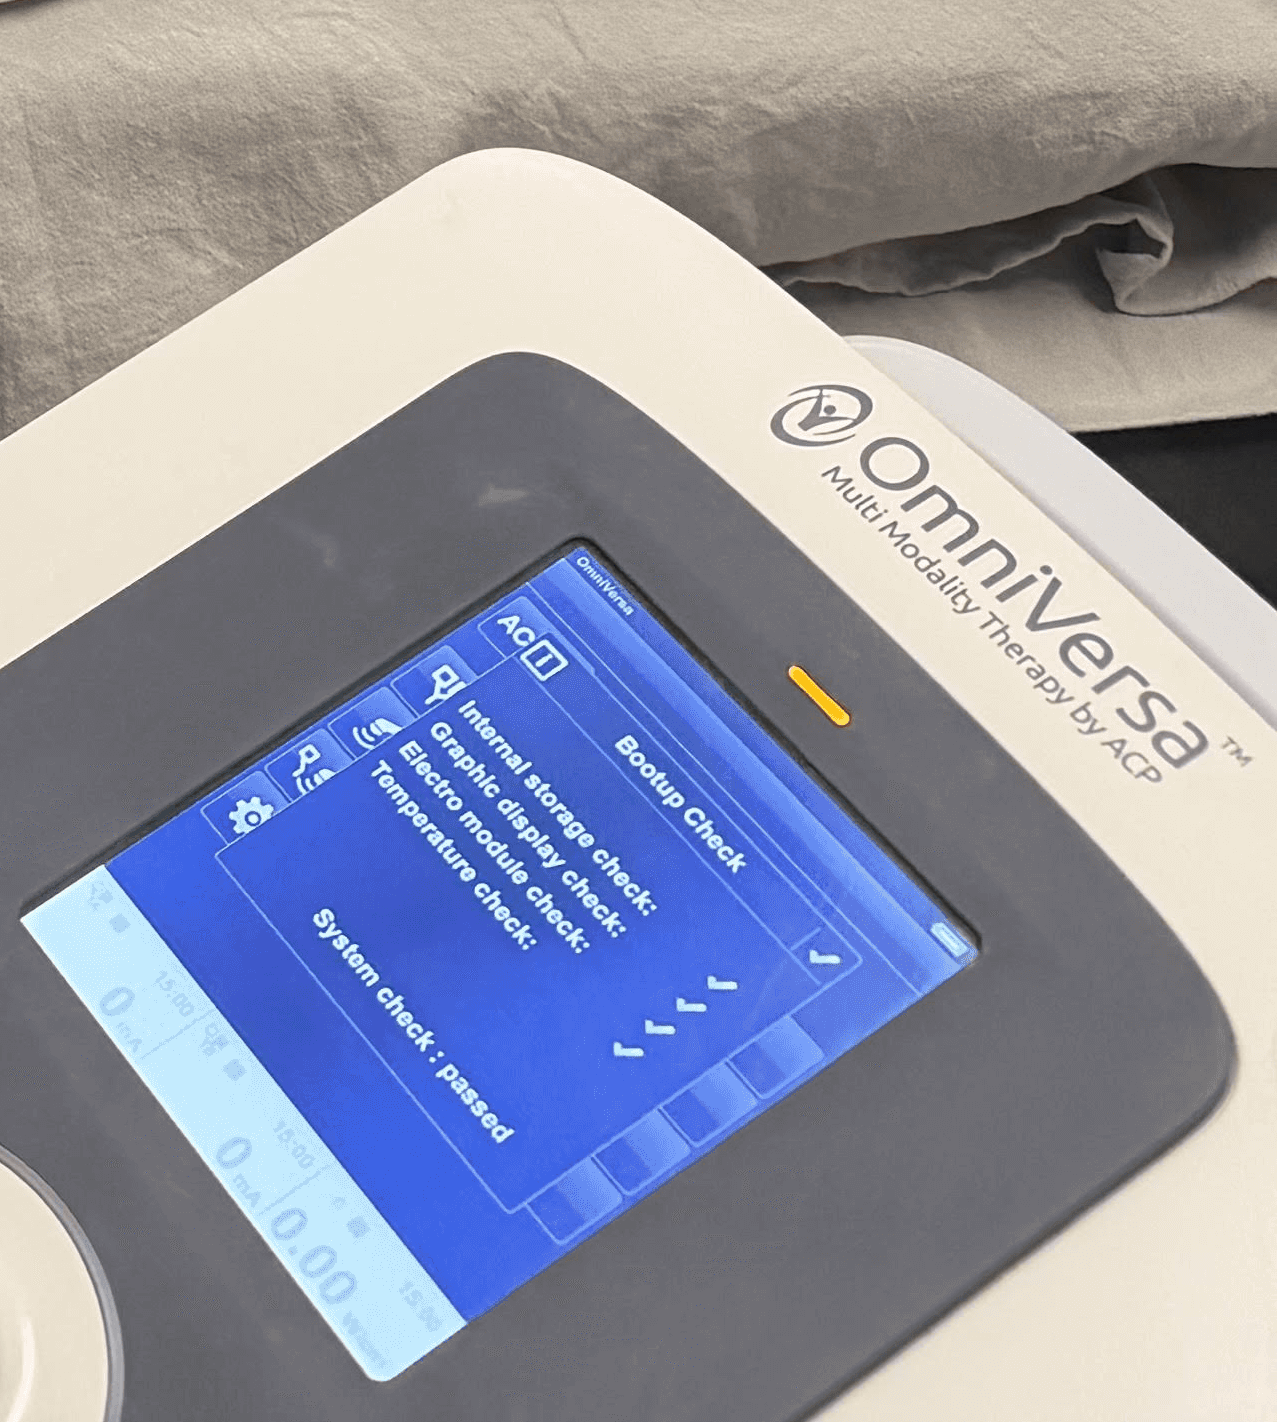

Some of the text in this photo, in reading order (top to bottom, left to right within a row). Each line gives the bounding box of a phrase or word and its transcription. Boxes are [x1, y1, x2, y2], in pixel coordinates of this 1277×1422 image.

[497, 615, 536, 647] AC
[576, 556, 634, 616] OmniVersa
[821, 465, 1163, 783] Multi Modality Therapy by ACP
[860, 437, 1209, 769] OmniVersa
[370, 759, 538, 951] Temperature check:
[398, 740, 590, 954] Electro module check:
[430, 721, 627, 938] Graphic display check:
[458, 700, 657, 916] Internal storage check:
[614, 734, 747, 874] Bootup Check
[99, 986, 136, 1017] 0
[313, 908, 380, 988] System
[435, 1063, 516, 1144] passed
[215, 1136, 253, 1169] 0
[270, 1207, 358, 1305] 0.00
